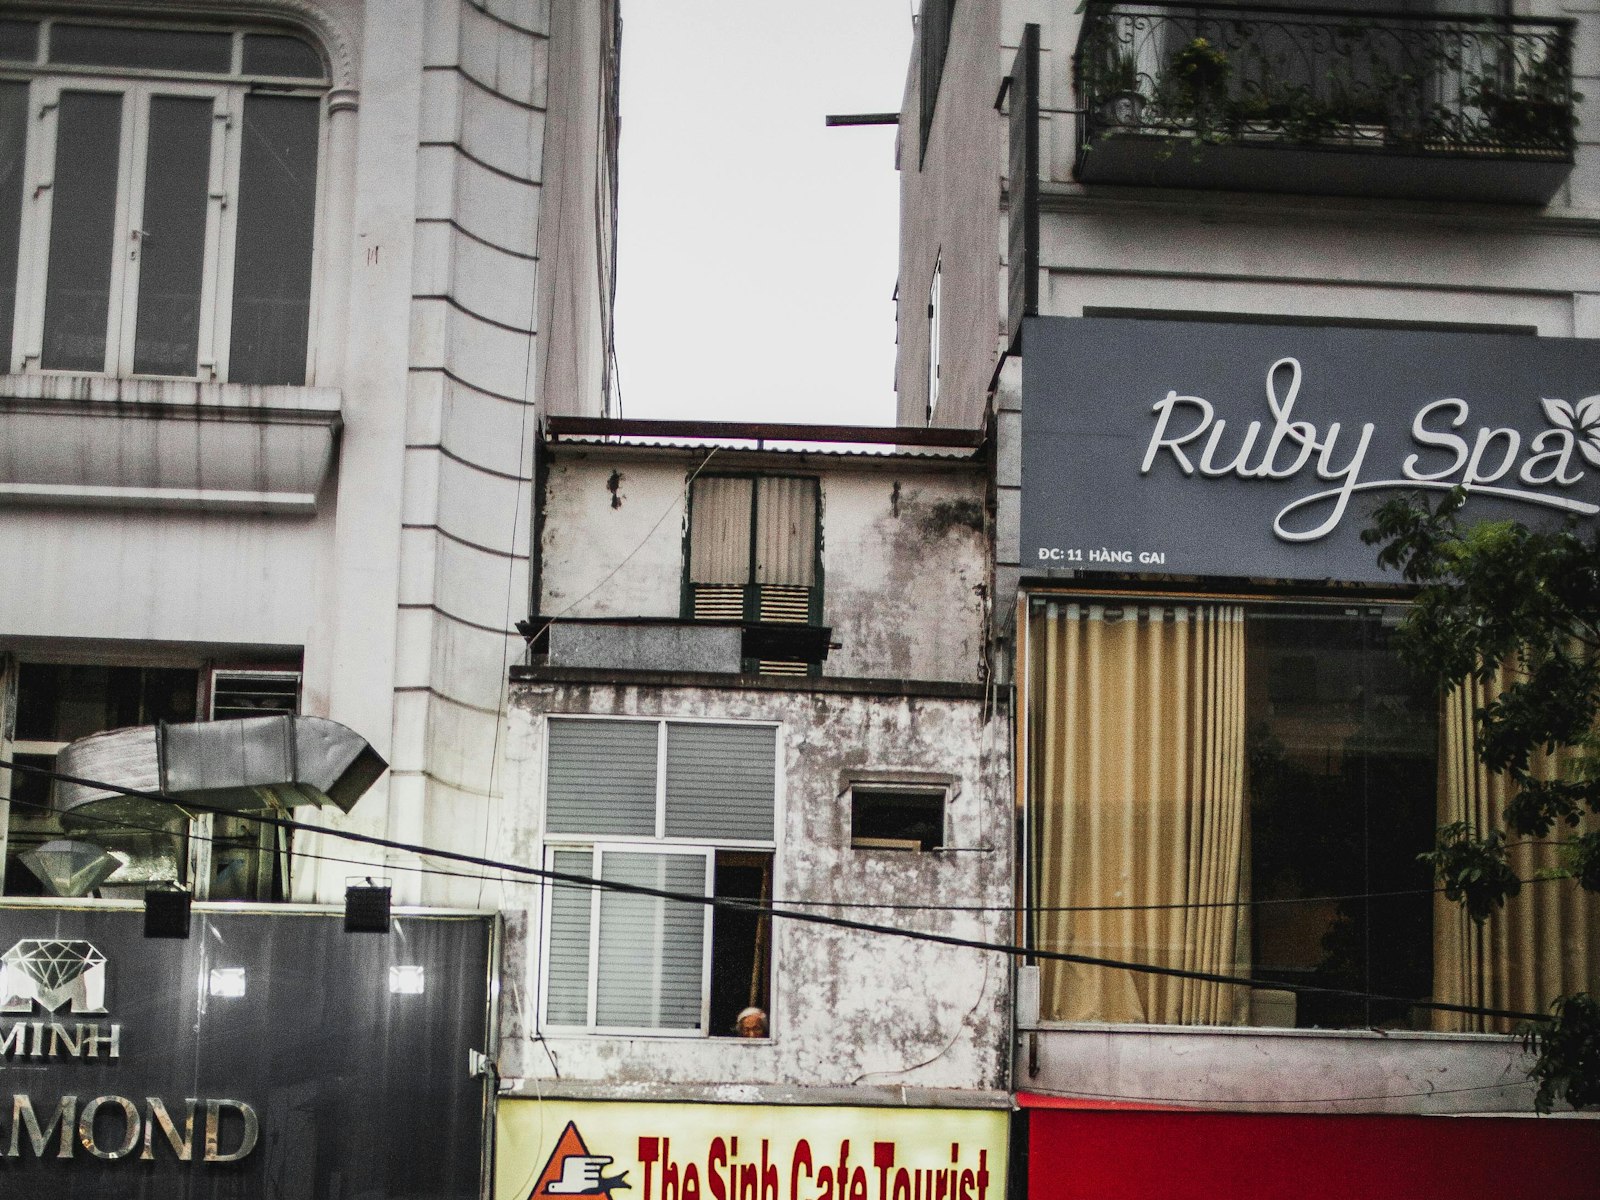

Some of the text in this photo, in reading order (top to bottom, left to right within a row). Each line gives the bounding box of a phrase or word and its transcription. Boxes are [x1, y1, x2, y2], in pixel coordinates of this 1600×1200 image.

[1141, 357, 1585, 543] Ruby Spa
[1088, 547, 1133, 563] HÀNG
[1139, 551, 1165, 564] GAI
[0, 1093, 259, 1162] MOND
